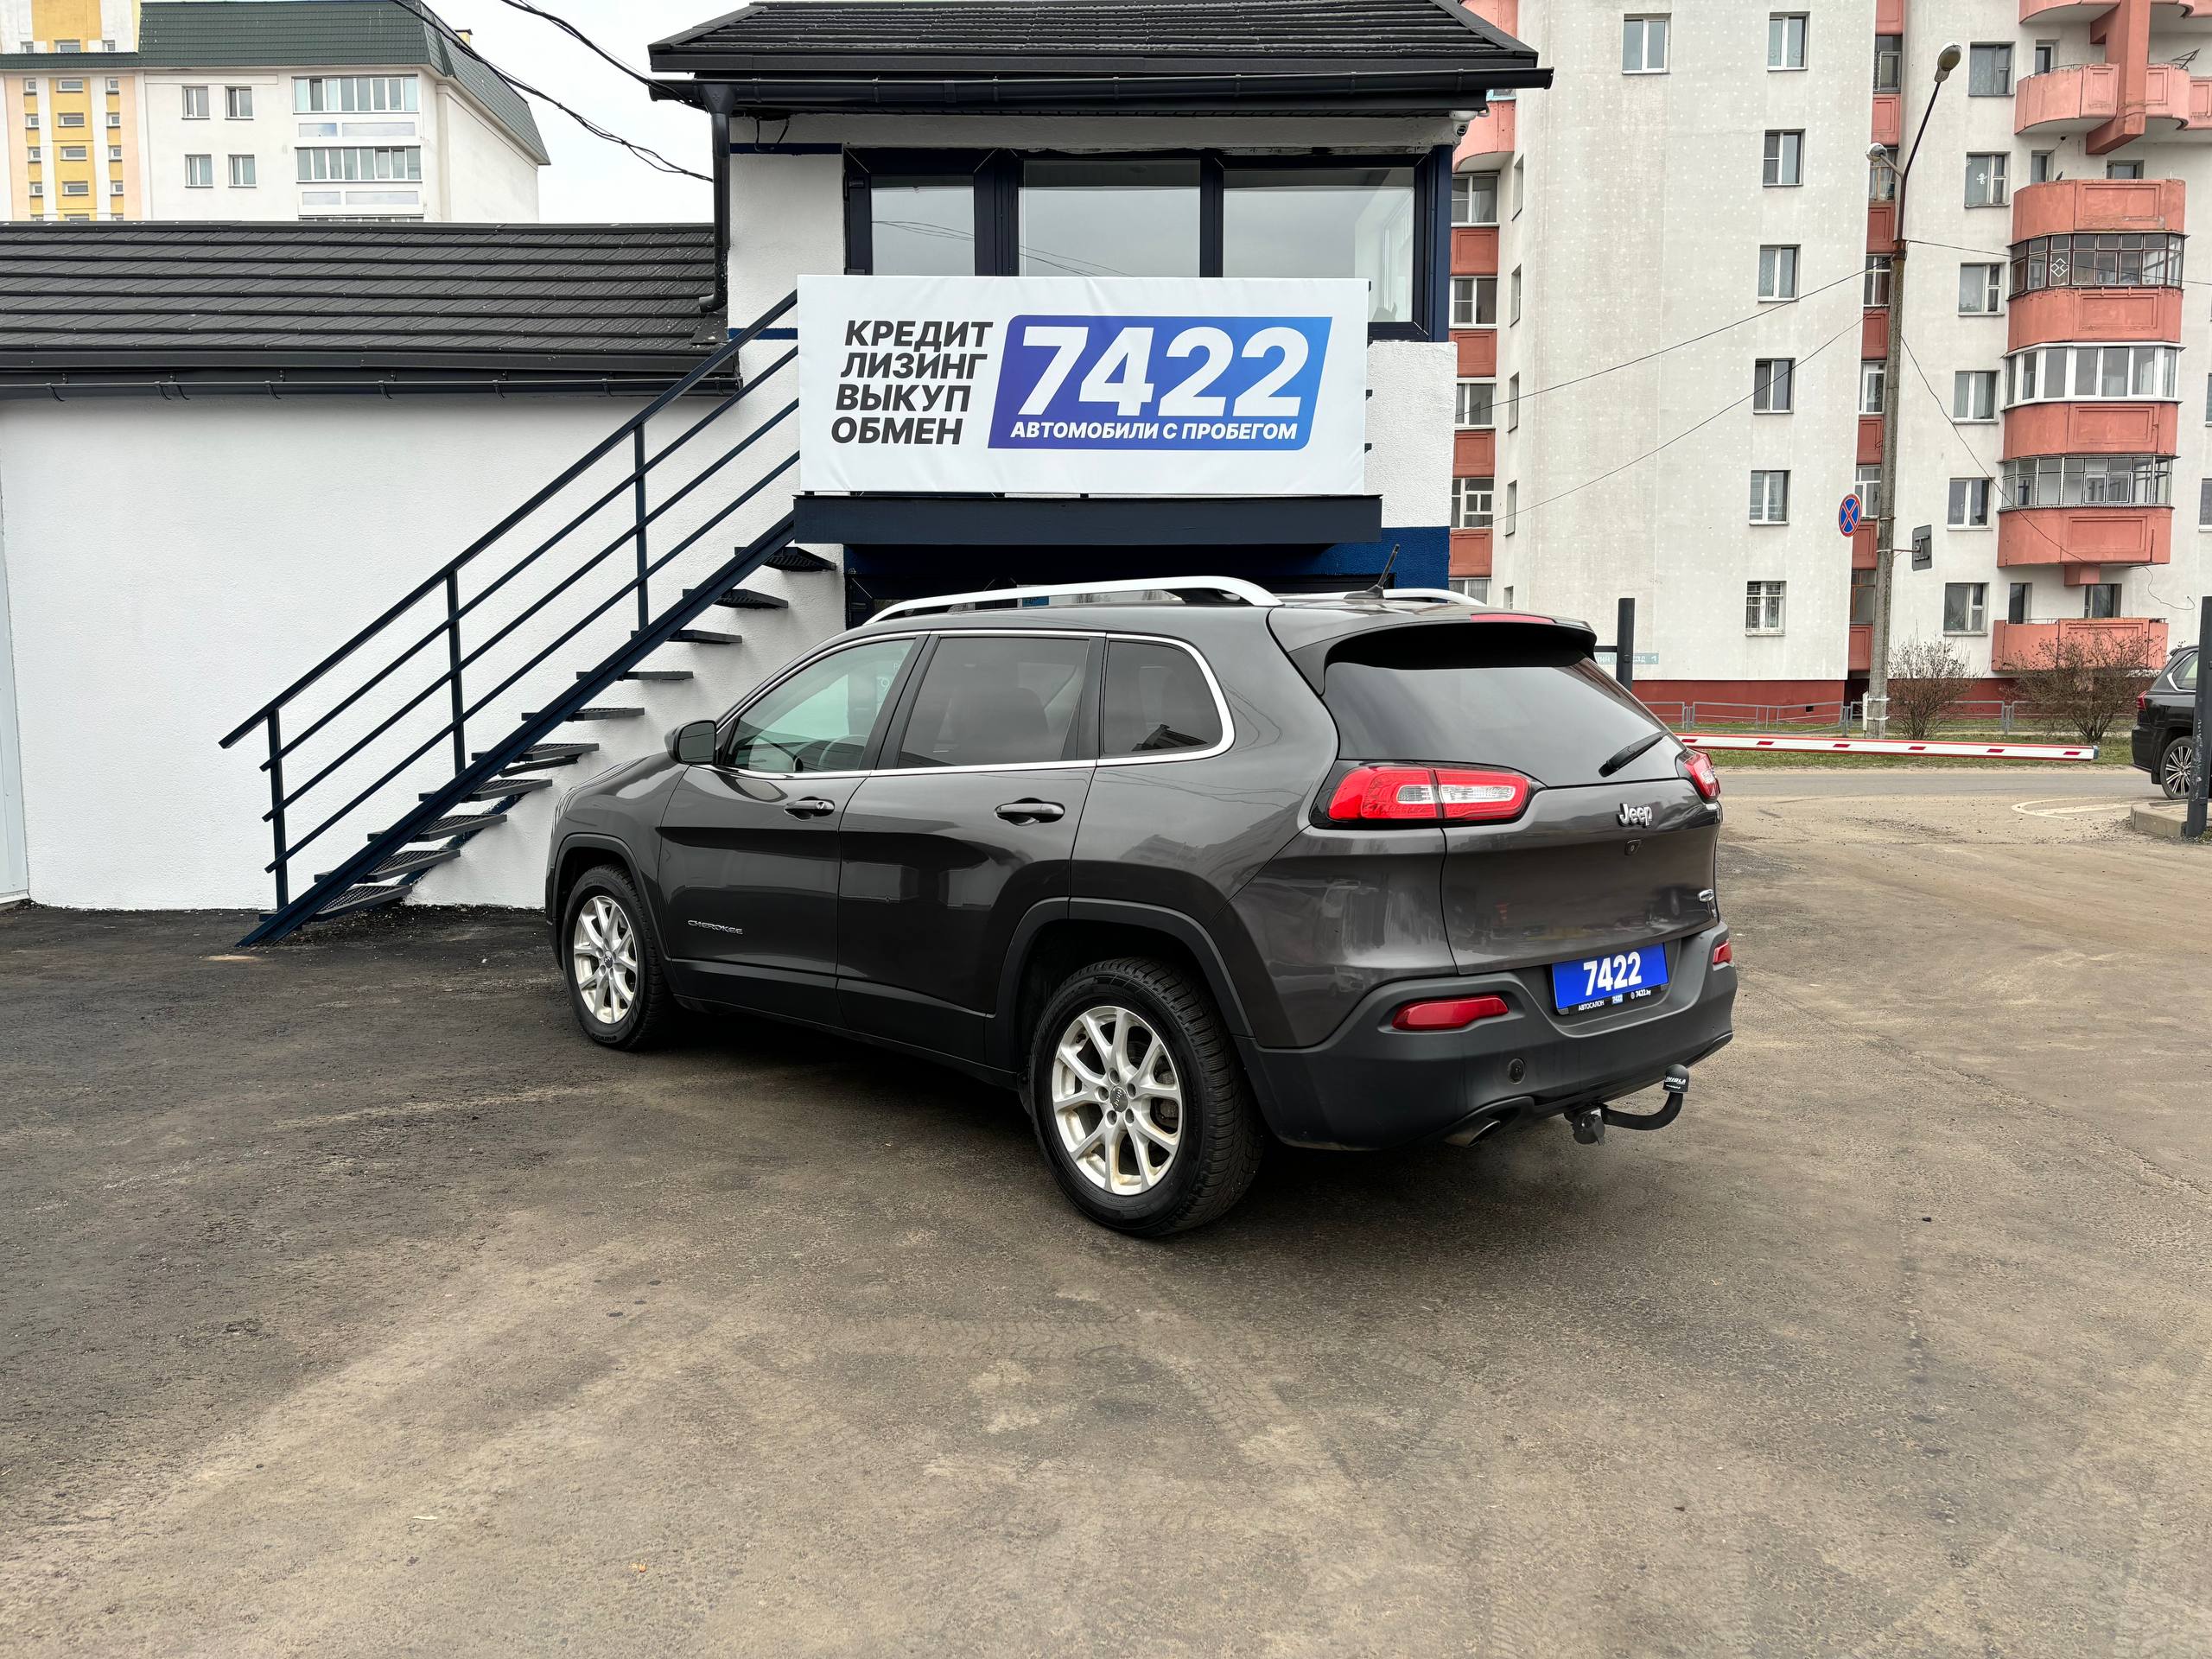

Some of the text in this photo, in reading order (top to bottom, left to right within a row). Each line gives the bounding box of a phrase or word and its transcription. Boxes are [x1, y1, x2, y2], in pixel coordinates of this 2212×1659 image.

[845, 321, 993, 352] КРЕДИТ
[841, 352, 988, 379] ЛИЗИНГ
[1018, 326, 1309, 416] 7422
[836, 385, 970, 411] ВЫКУП
[831, 417, 963, 444] ОБМЕН
[1011, 421, 1297, 440] АВТОМОБИЛИ С ПРОБЕГОМ
[1619, 803, 1653, 827] Jeep
[688, 920, 743, 934] CHEROKEE
[1583, 951, 1643, 996] 7422
[1578, 1000, 1605, 1012] АВТОСАЛОН
